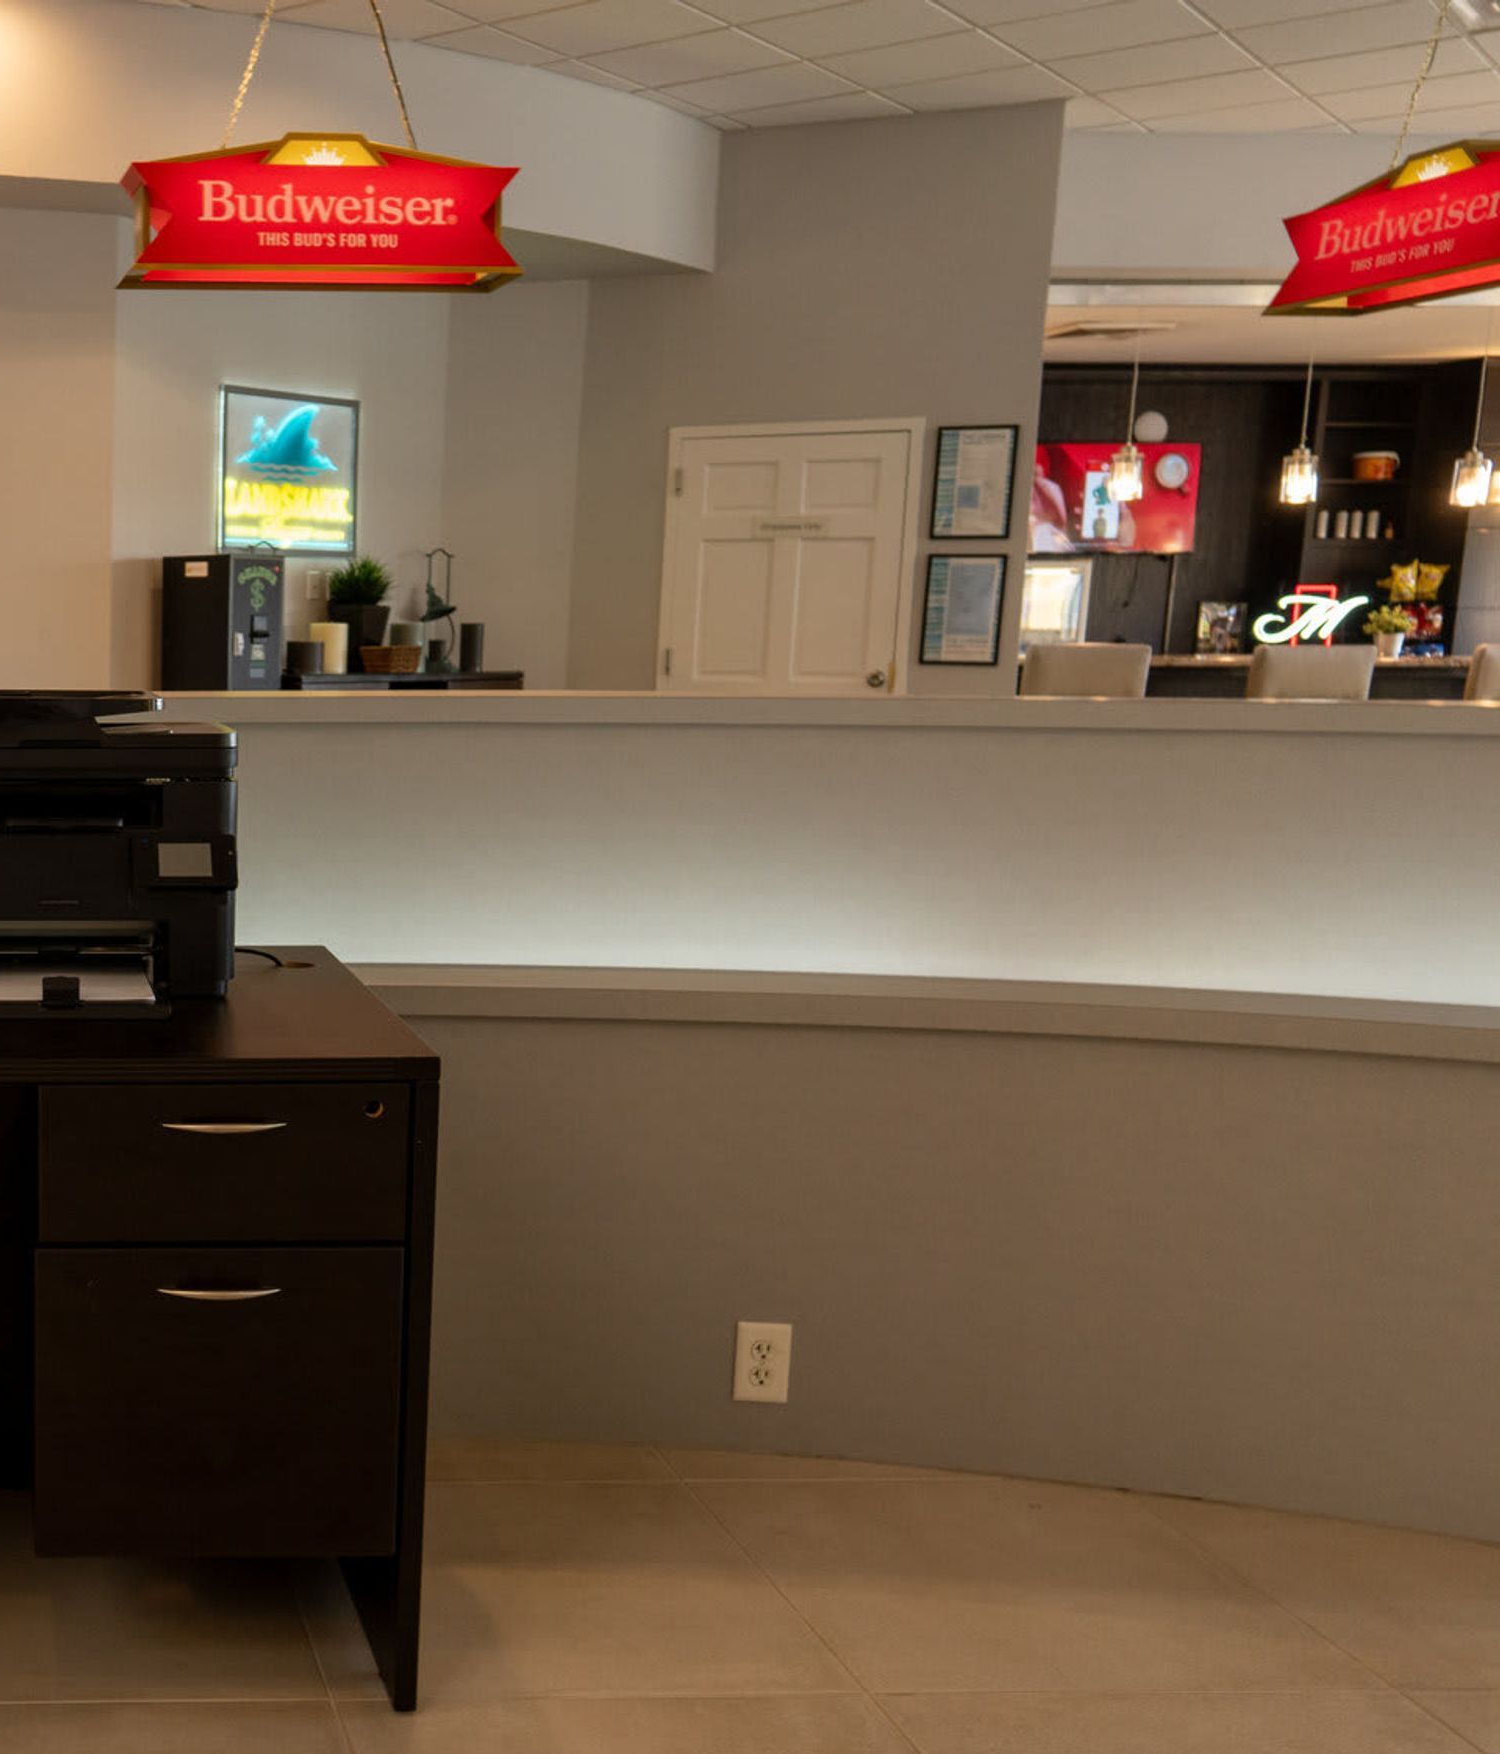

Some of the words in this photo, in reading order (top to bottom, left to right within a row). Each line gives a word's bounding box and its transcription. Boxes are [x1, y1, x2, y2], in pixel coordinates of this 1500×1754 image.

[198, 180, 453, 225] Budweiser
[258, 231, 290, 247] THIS
[293, 232, 336, 248] BUD'S
[339, 233, 367, 248] FOR
[370, 233, 399, 249] YOU
[1352, 259, 1373, 272] THIS
[1410, 244, 1430, 259] FOR
[1433, 238, 1455, 254] YOU
